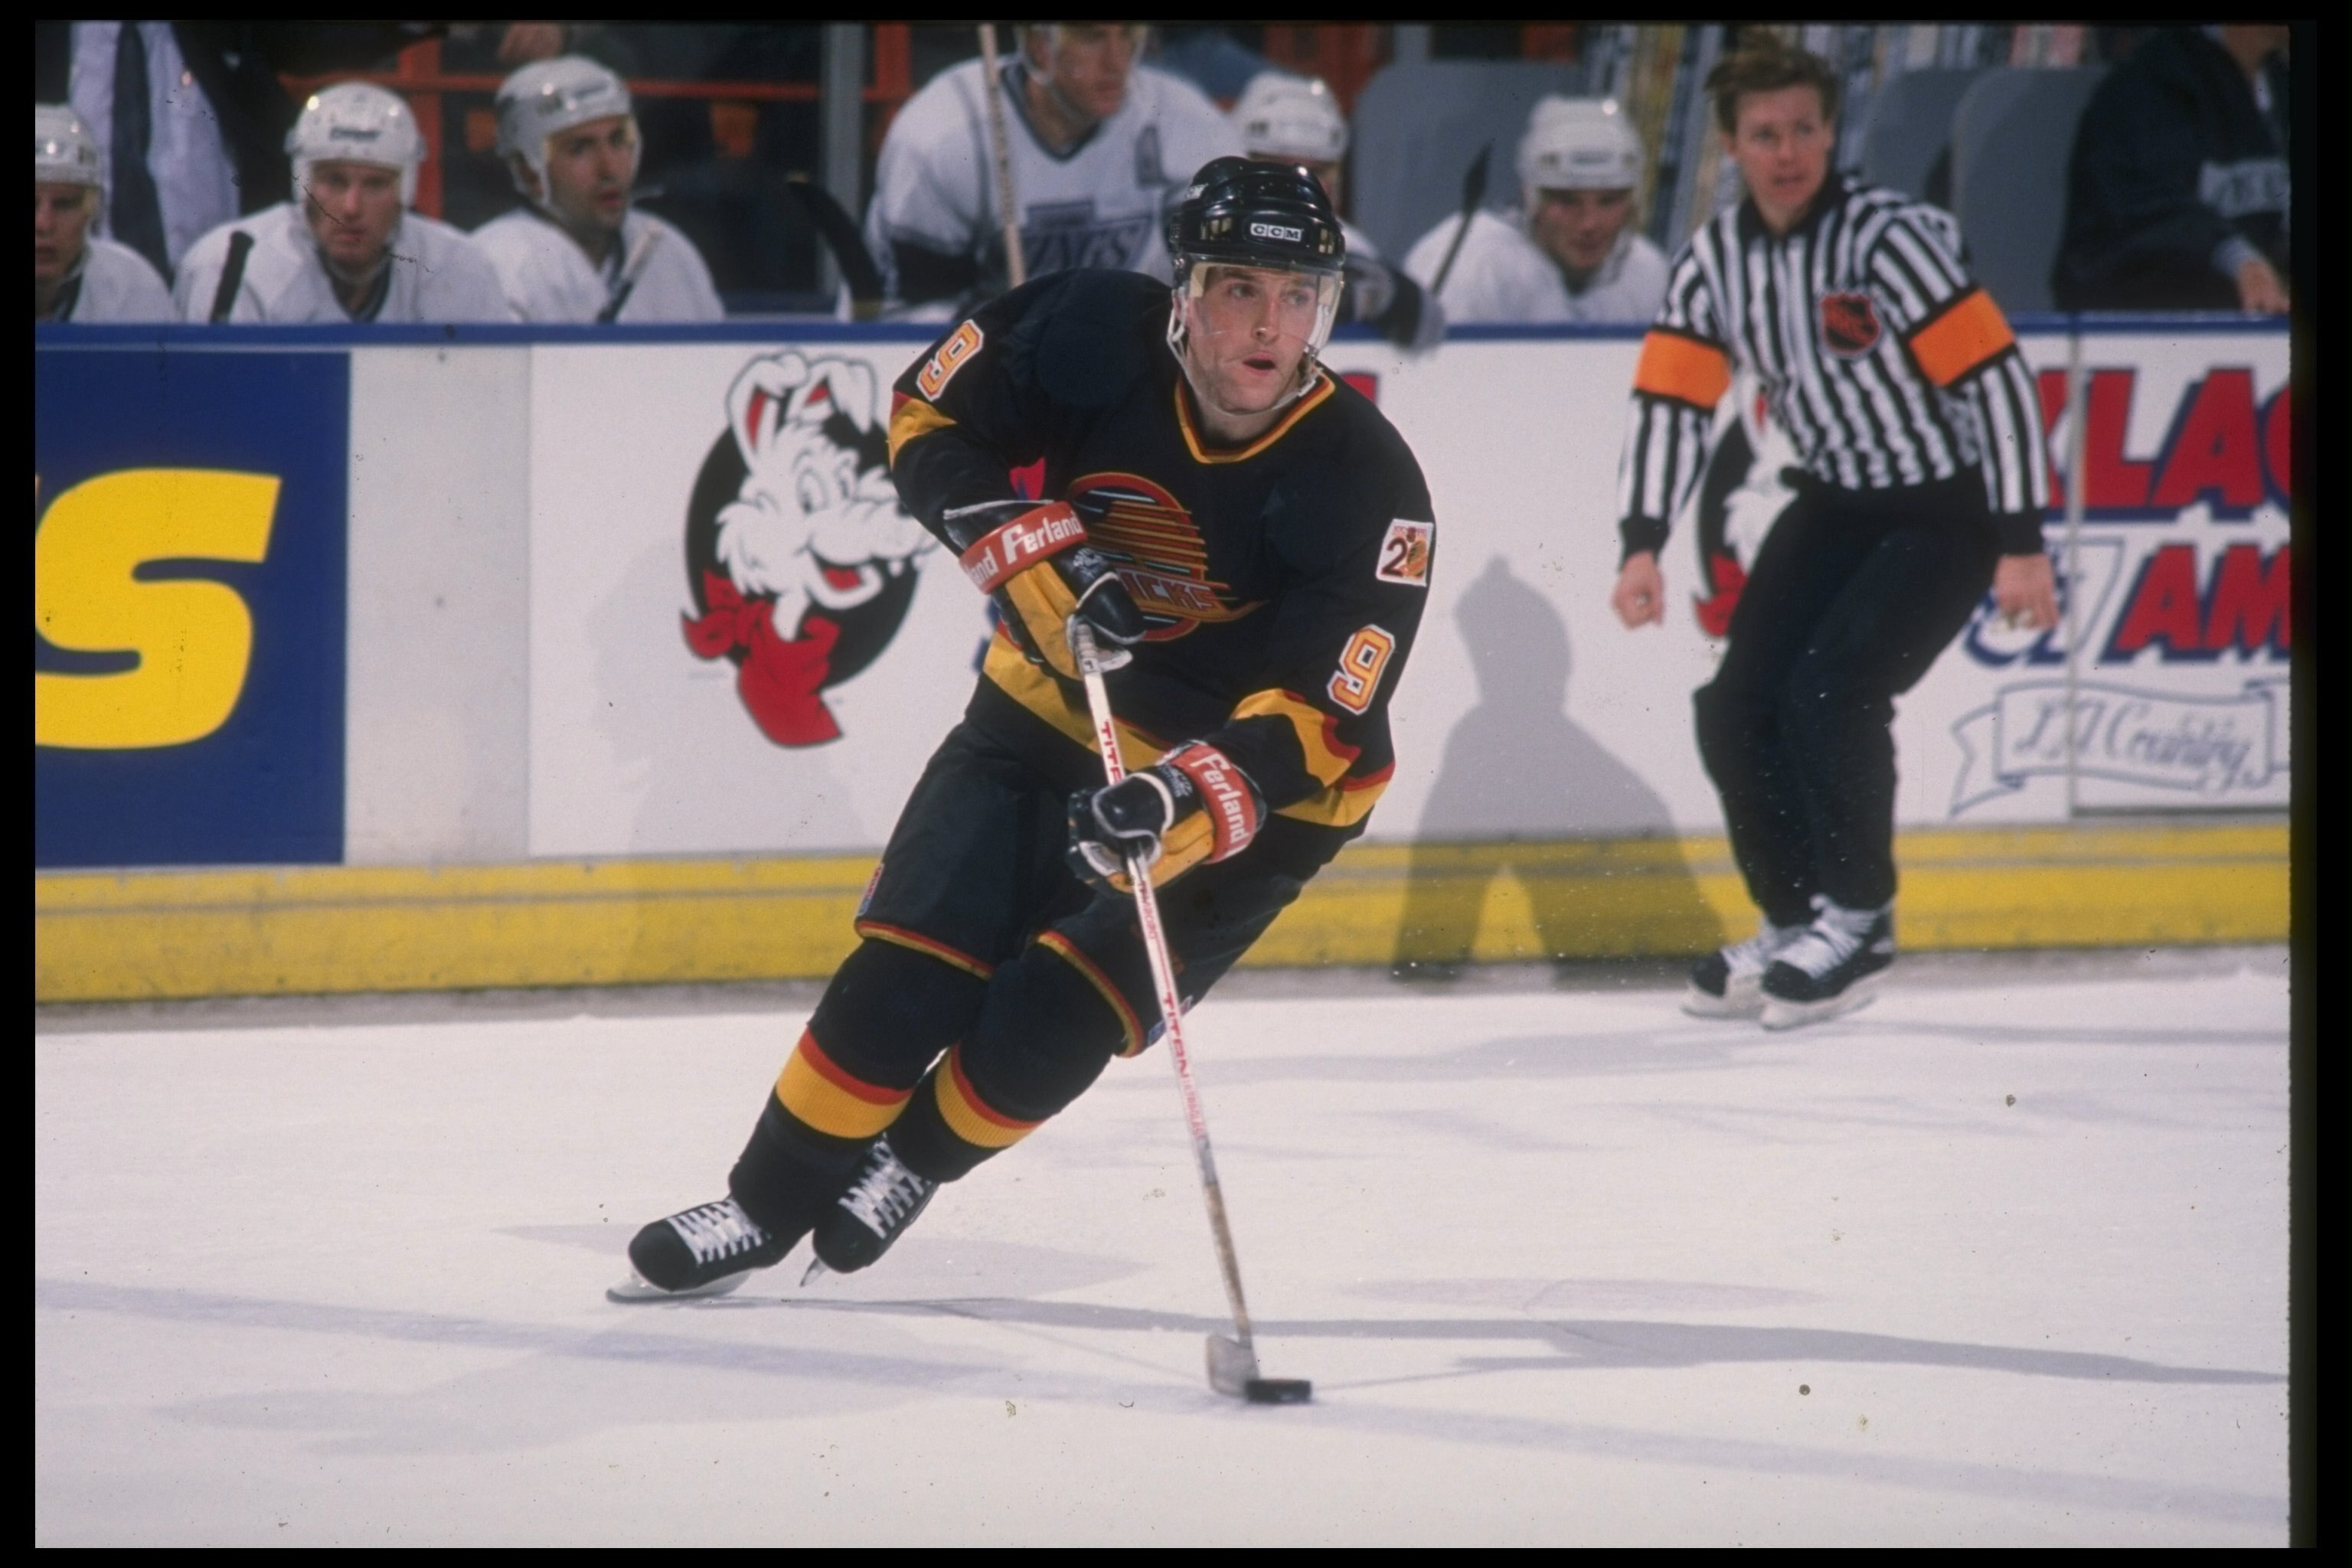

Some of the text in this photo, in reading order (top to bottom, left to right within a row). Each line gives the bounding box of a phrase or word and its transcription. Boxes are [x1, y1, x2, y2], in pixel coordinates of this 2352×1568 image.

[1251, 224, 1301, 242] CCM
[916, 319, 984, 401] 9
[1001, 510, 1084, 565] Ferland
[1327, 624, 1396, 715] 9
[1100, 719, 1123, 786] TITA
[1190, 753, 1250, 844] Ferland
[1163, 991, 1189, 1079] TITAN
